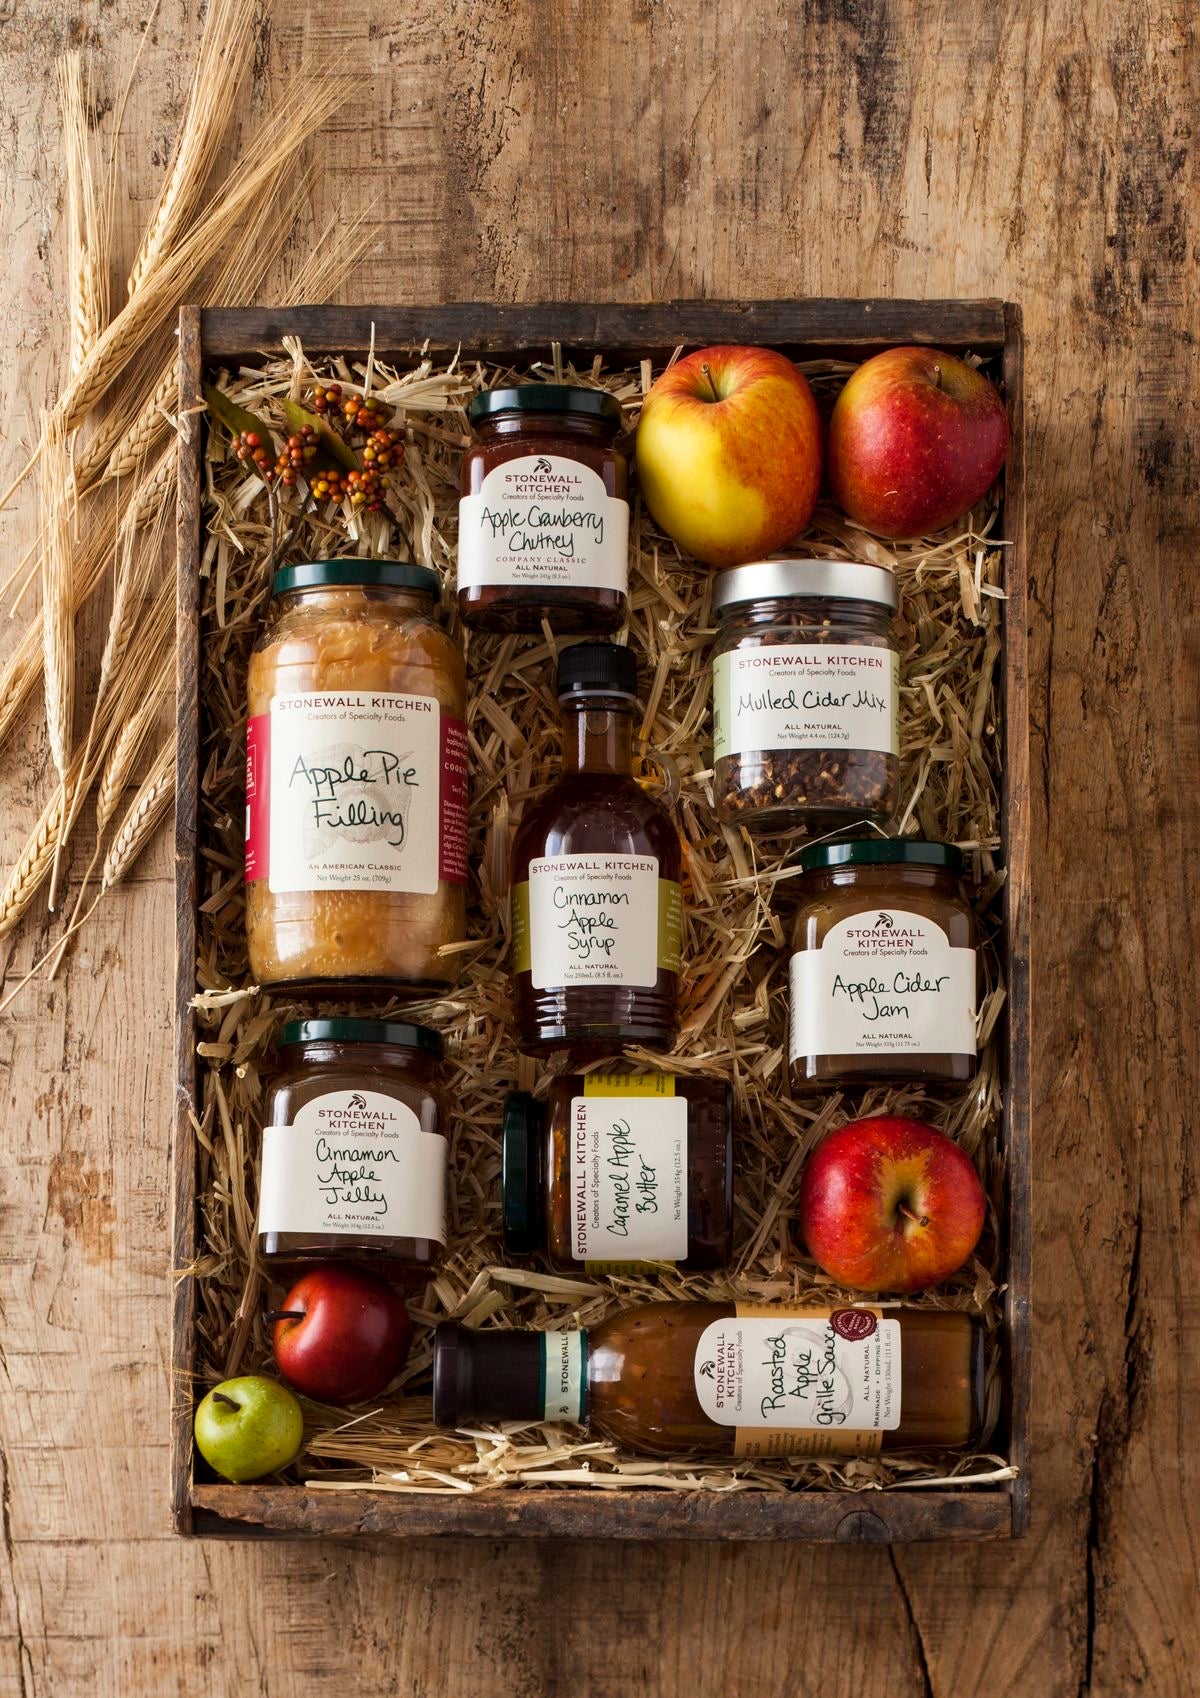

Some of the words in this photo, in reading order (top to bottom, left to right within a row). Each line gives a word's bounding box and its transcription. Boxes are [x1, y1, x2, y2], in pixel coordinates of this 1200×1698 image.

[505, 474, 582, 484] STONEWALL
[516, 484, 570, 493] KITCHEN
[537, 492, 564, 502] Specialty
[480, 506, 526, 538] Apple
[527, 505, 604, 544] Cranberry
[508, 531, 574, 558] Chutney
[738, 656, 822, 670] STONEWALL
[827, 656, 883, 668] KITCHEN
[806, 669, 836, 678] Specialty
[280, 698, 366, 710] STONEWALL
[372, 698, 432, 712] KITCHEN
[738, 689, 799, 716] Mulled
[803, 690, 851, 710] Cider
[852, 690, 888, 713] Mix
[308, 712, 338, 721] Creators
[339, 712, 347, 720] of
[349, 712, 382, 722] Specialty
[384, 714, 405, 722] Foods
[288, 754, 377, 797] Apple
[364, 750, 420, 787] Pie
[312, 798, 404, 846] Filling
[330, 874, 351, 882] Weight
[532, 862, 600, 874] STONEWALL
[605, 862, 654, 872] KITCHEN
[586, 874, 614, 882] Specialty
[553, 886, 630, 909] Cinnamon
[558, 908, 620, 934] Apple
[846, 929, 926, 938] STONEWALL
[568, 932, 616, 959] Syrup
[844, 949, 870, 957] Creators
[879, 949, 908, 958] Specialty
[858, 940, 914, 948] KITCHEN
[832, 974, 890, 1002] Apple
[893, 972, 950, 994] Cider
[862, 996, 910, 1020] Jam
[318, 1110, 398, 1121] STONEWALL
[329, 1120, 386, 1130] KITCHEN
[350, 1130, 379, 1139] Specialty
[576, 1104, 587, 1164] KITCHEN
[592, 1131, 600, 1154] Foods
[606, 1118, 636, 1168] Apple
[316, 1138, 400, 1162] Cinnamon
[318, 1163, 382, 1186] Apple
[592, 1155, 601, 1188] Specialty
[635, 1154, 659, 1214] Butter
[318, 1186, 388, 1214] Jelly
[592, 1190, 599, 1198] of
[606, 1172, 630, 1237] Caramel
[577, 1170, 588, 1254] STONEWALL
[592, 1198, 600, 1229] Creators
[561, 1336, 569, 1393] STONEWALL
[716, 1332, 725, 1408] STONEWALL
[726, 1342, 736, 1398] KITCHEN
[736, 1347, 744, 1376] Specialty
[788, 1348, 818, 1400] Apple
[761, 1334, 787, 1419] Roasted
[873, 1389, 881, 1427] MARINADE
